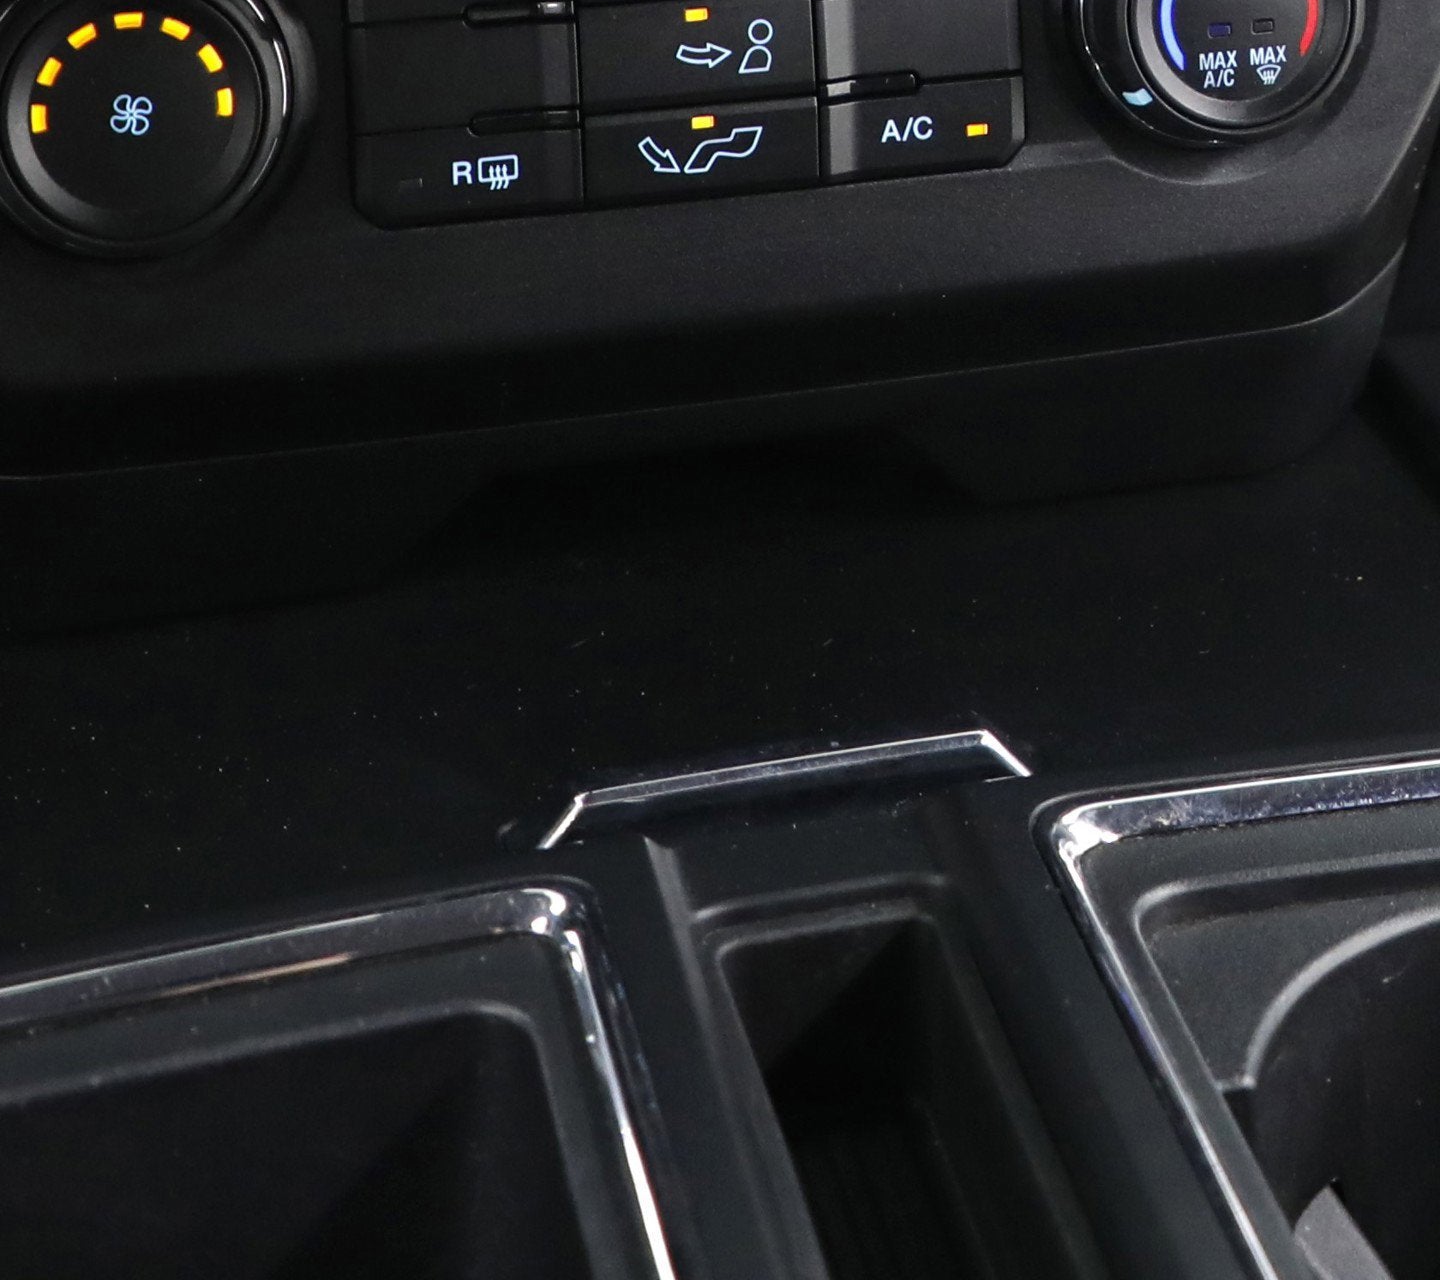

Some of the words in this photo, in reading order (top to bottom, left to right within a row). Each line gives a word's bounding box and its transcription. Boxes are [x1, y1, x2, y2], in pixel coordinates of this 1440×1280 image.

[1199, 49, 1238, 71] MAX
[1249, 44, 1287, 66] MAX
[1203, 68, 1235, 89] A/C
[881, 115, 933, 143] A/C
[452, 160, 473, 186] R
